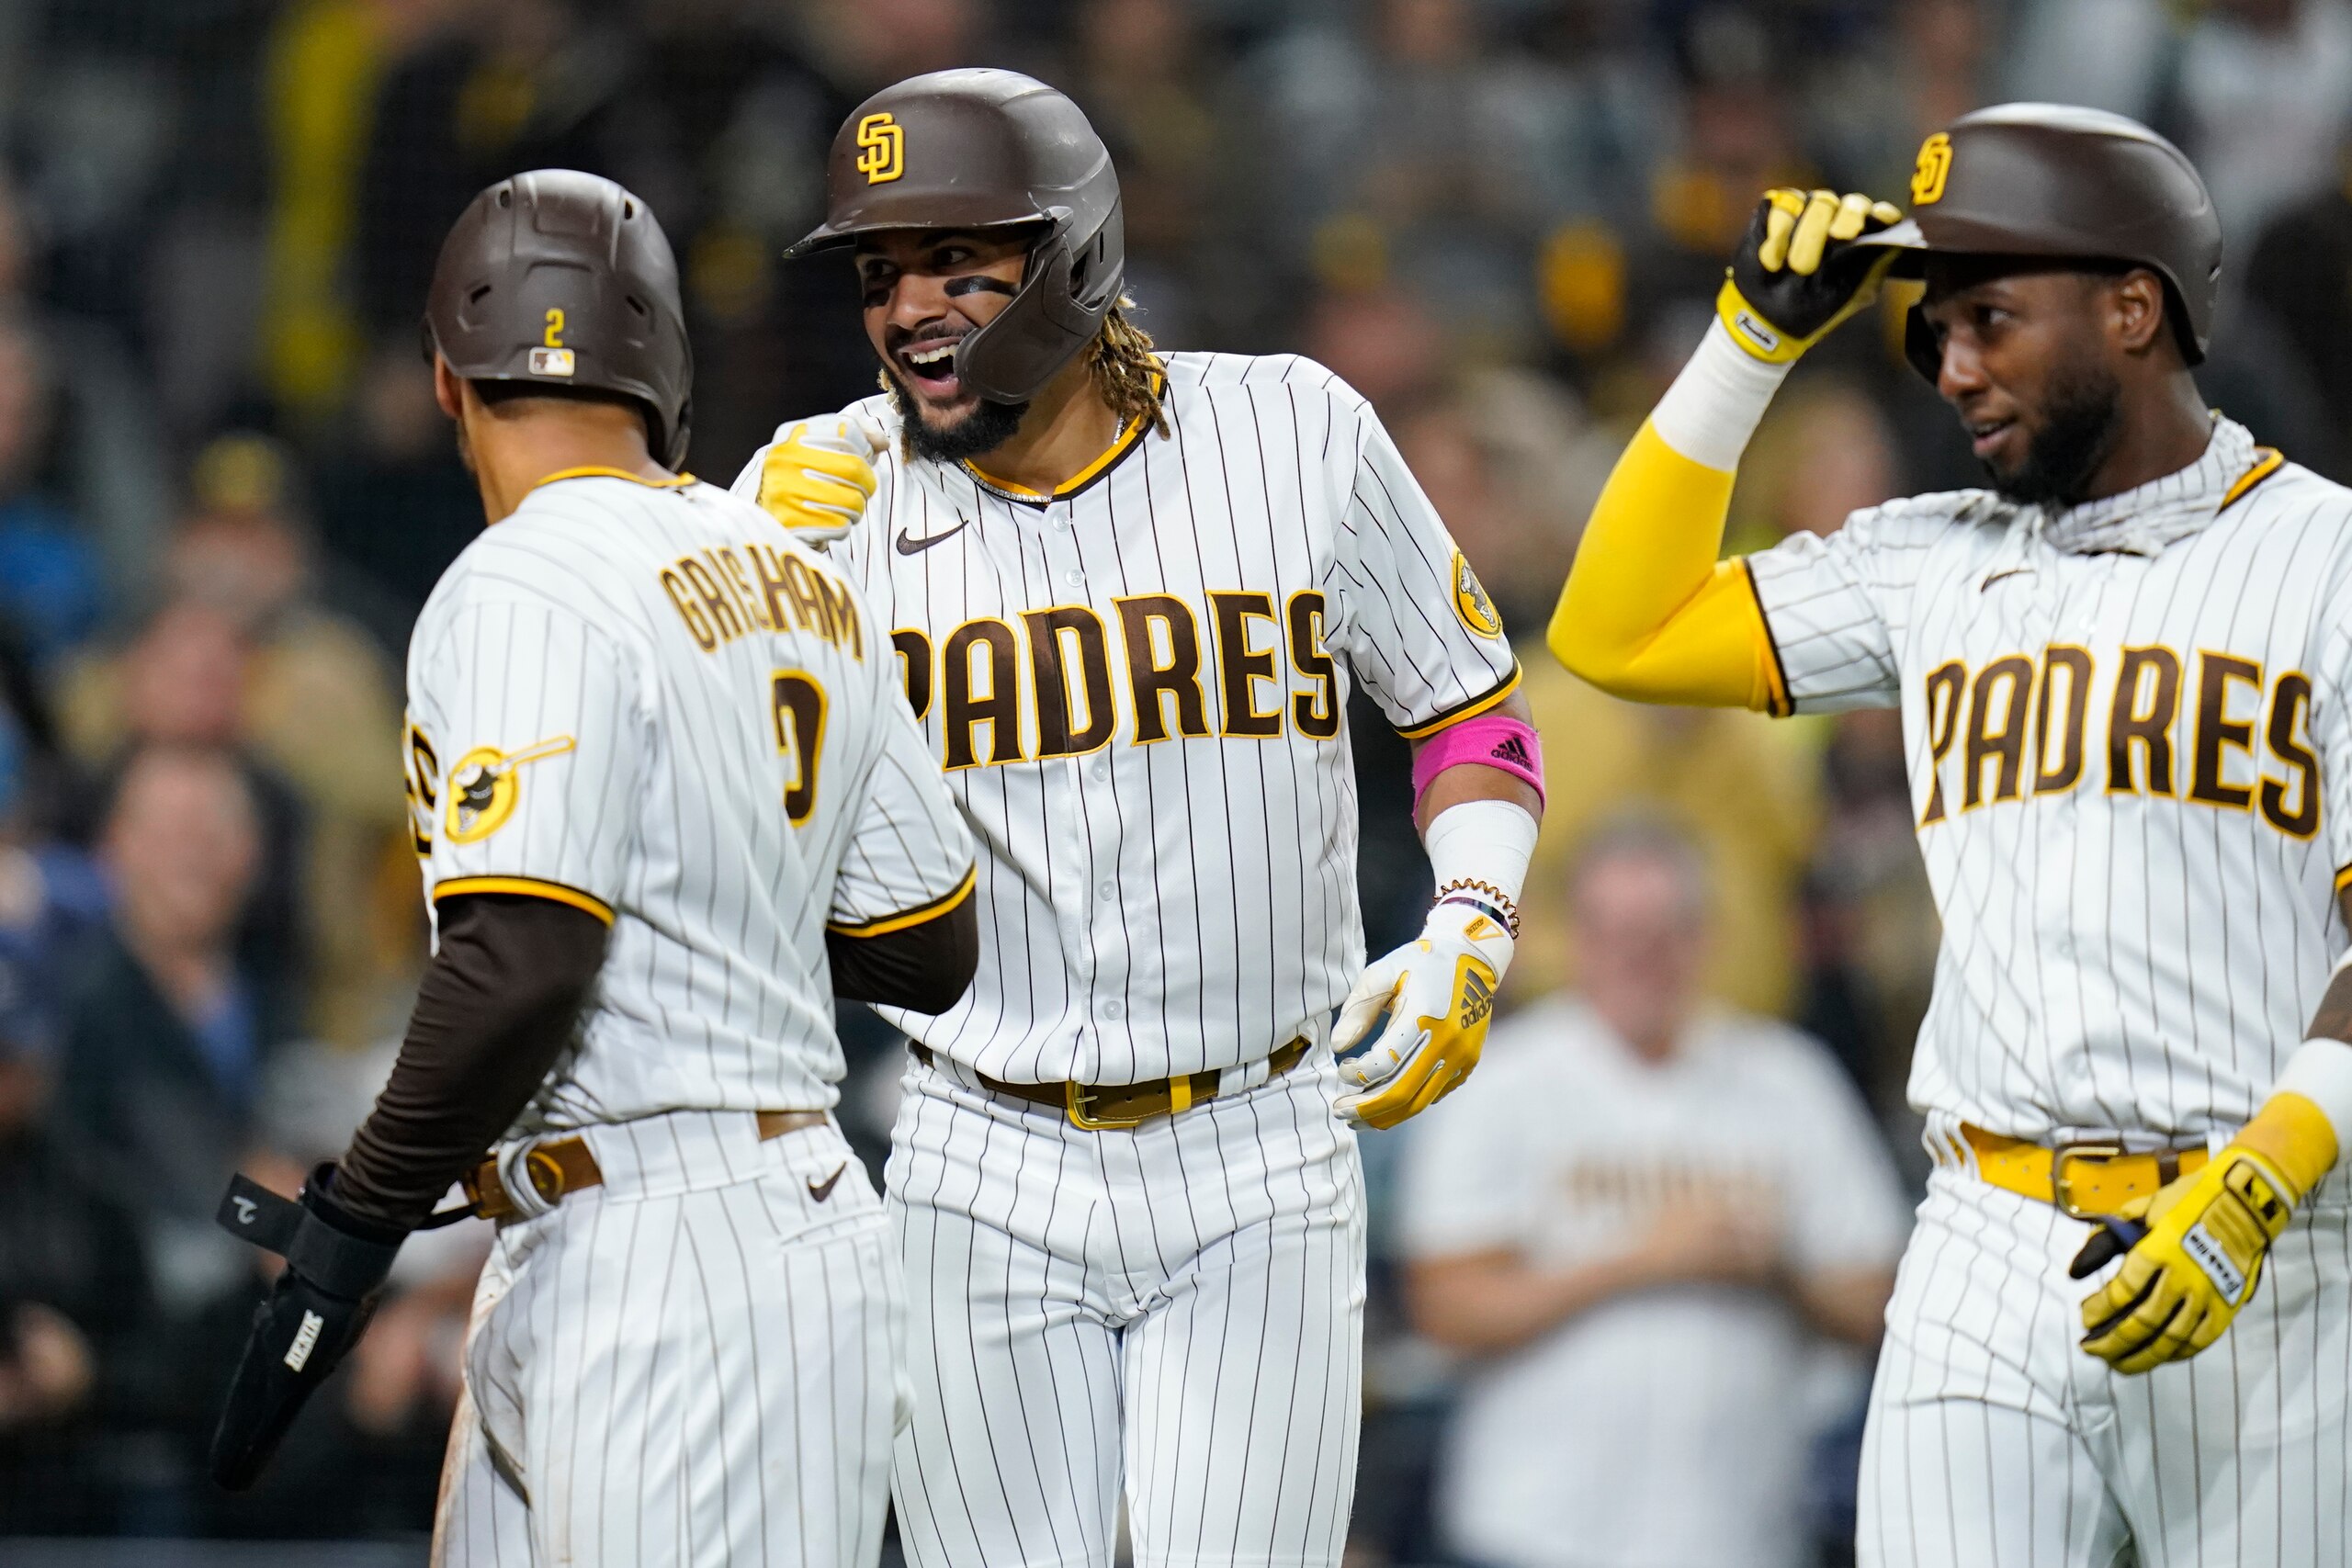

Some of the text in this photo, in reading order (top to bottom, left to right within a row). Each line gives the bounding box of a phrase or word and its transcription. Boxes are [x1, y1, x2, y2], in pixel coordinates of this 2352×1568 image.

[856, 111, 905, 186] SD
[1910, 131, 1953, 206] SD
[544, 308, 565, 348] 2
[658, 543, 864, 664] GRISHAM
[1490, 749, 1533, 772] adidas
[1916, 642, 2322, 842] PADRES
